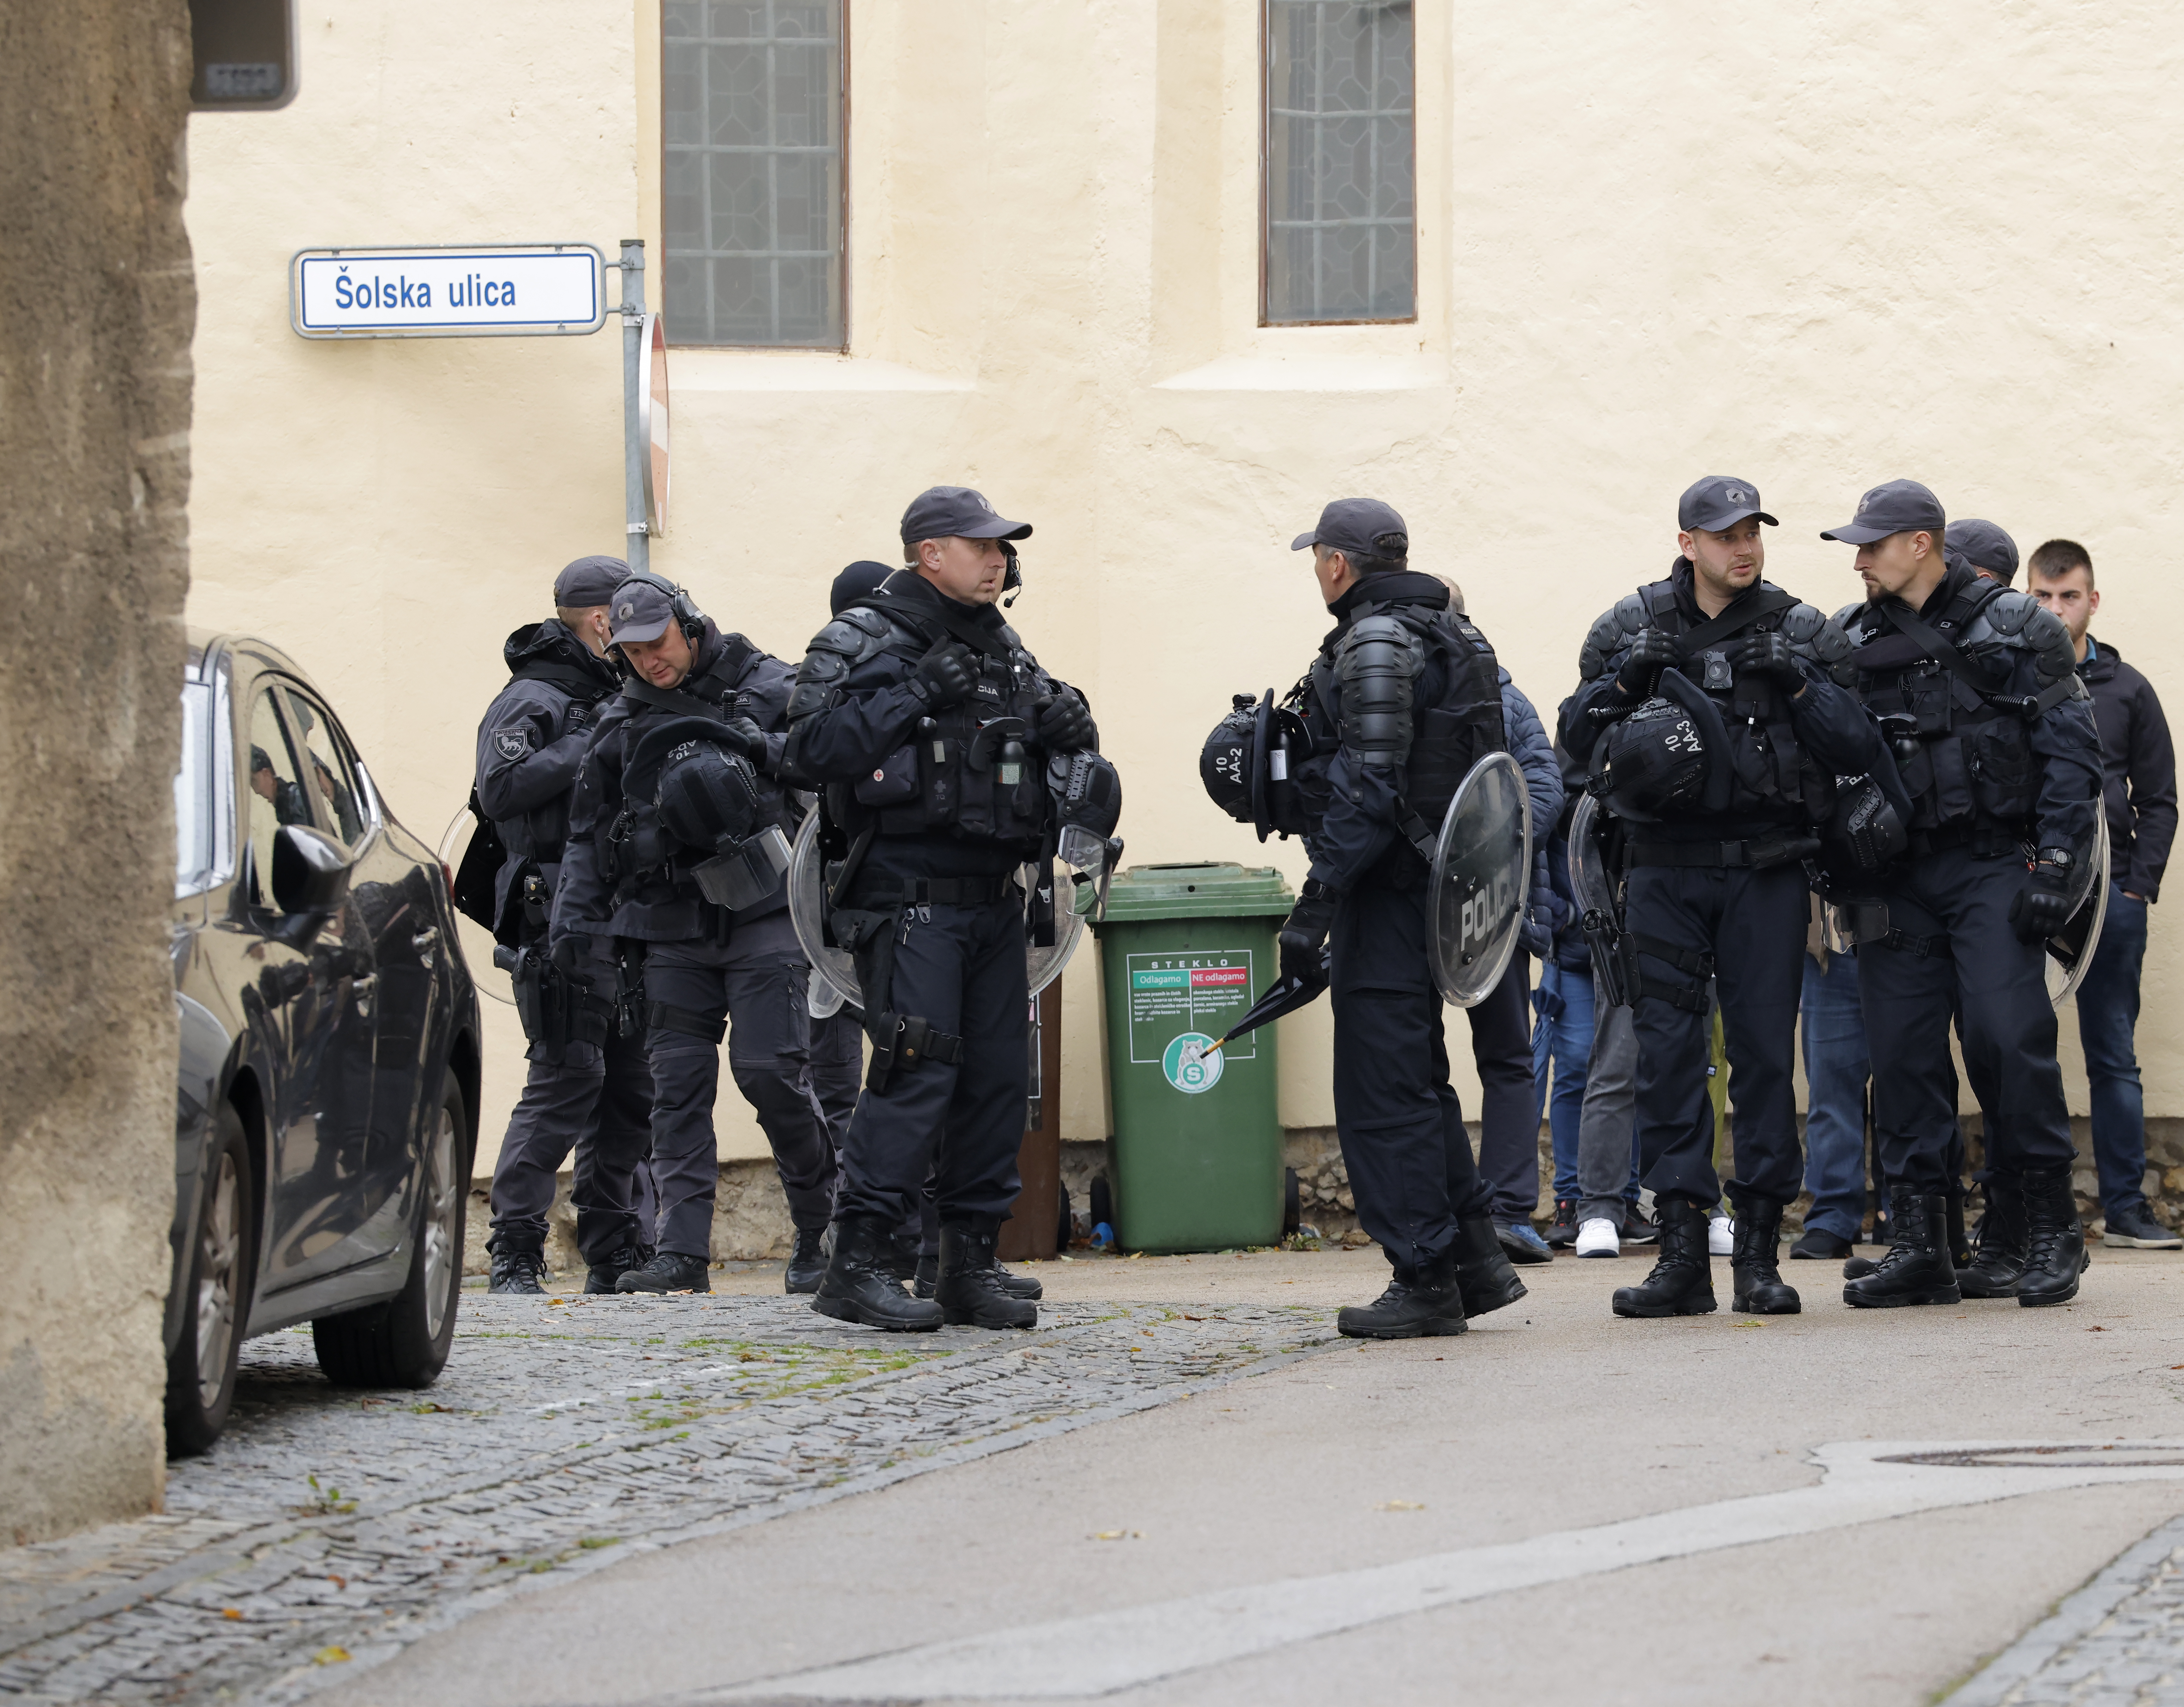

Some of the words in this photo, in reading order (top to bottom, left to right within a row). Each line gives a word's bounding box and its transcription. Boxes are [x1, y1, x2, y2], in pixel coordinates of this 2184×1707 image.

[335, 265, 432, 309] Šolska
[449, 274, 516, 307] ulica
[1665, 735, 1682, 752] 10
[1676, 720, 1702, 752] AA-3
[667, 740, 697, 758] AD-2
[676, 750, 690, 760] 10
[1215, 757, 1227, 773] 10
[1229, 748, 1242, 784] AA-2
[1151, 959, 1228, 969] STEKLO
[1140, 976, 1181, 985] Odlagamo
[1206, 973, 1245, 983] odlagamo
[1187, 1067, 1201, 1081] S
